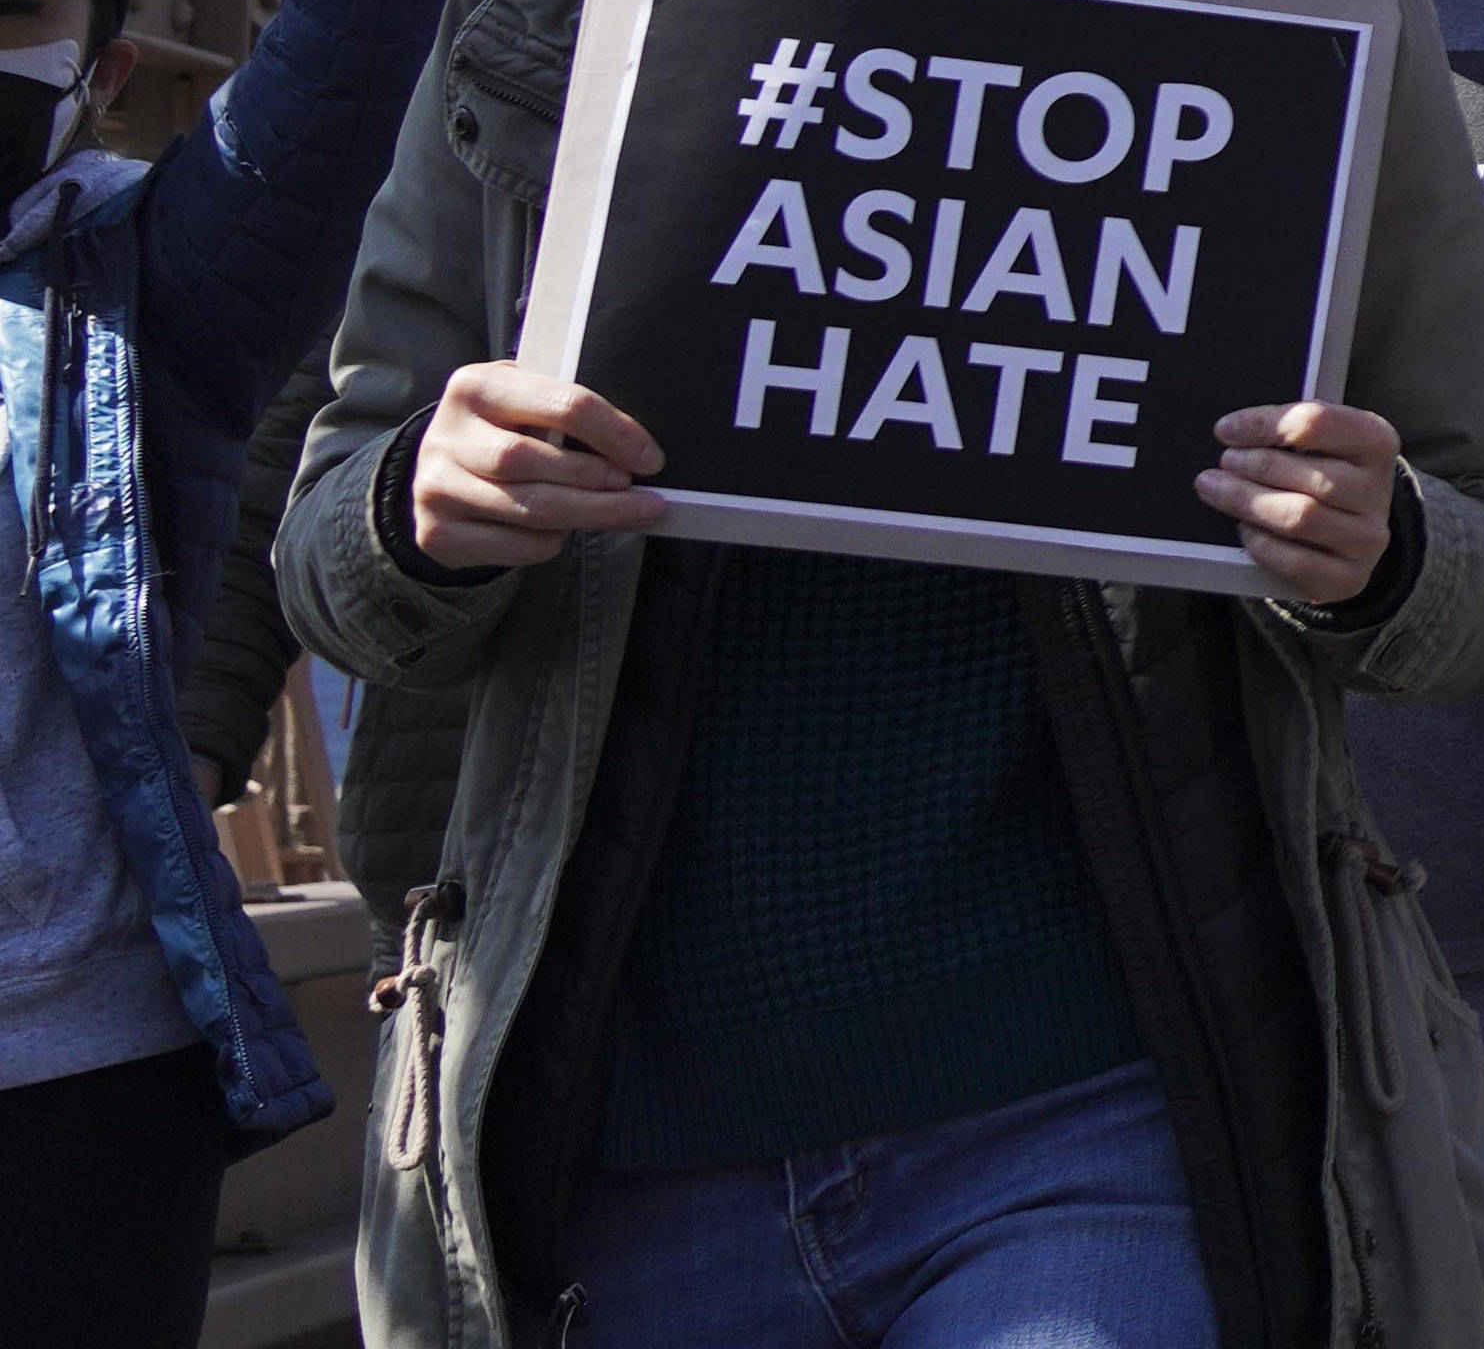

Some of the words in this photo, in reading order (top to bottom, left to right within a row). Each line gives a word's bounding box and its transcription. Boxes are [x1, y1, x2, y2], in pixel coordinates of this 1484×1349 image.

[738, 36, 1235, 193] #STOP
[710, 178, 1202, 336] ASIAN
[733, 319, 1151, 470] HATE
